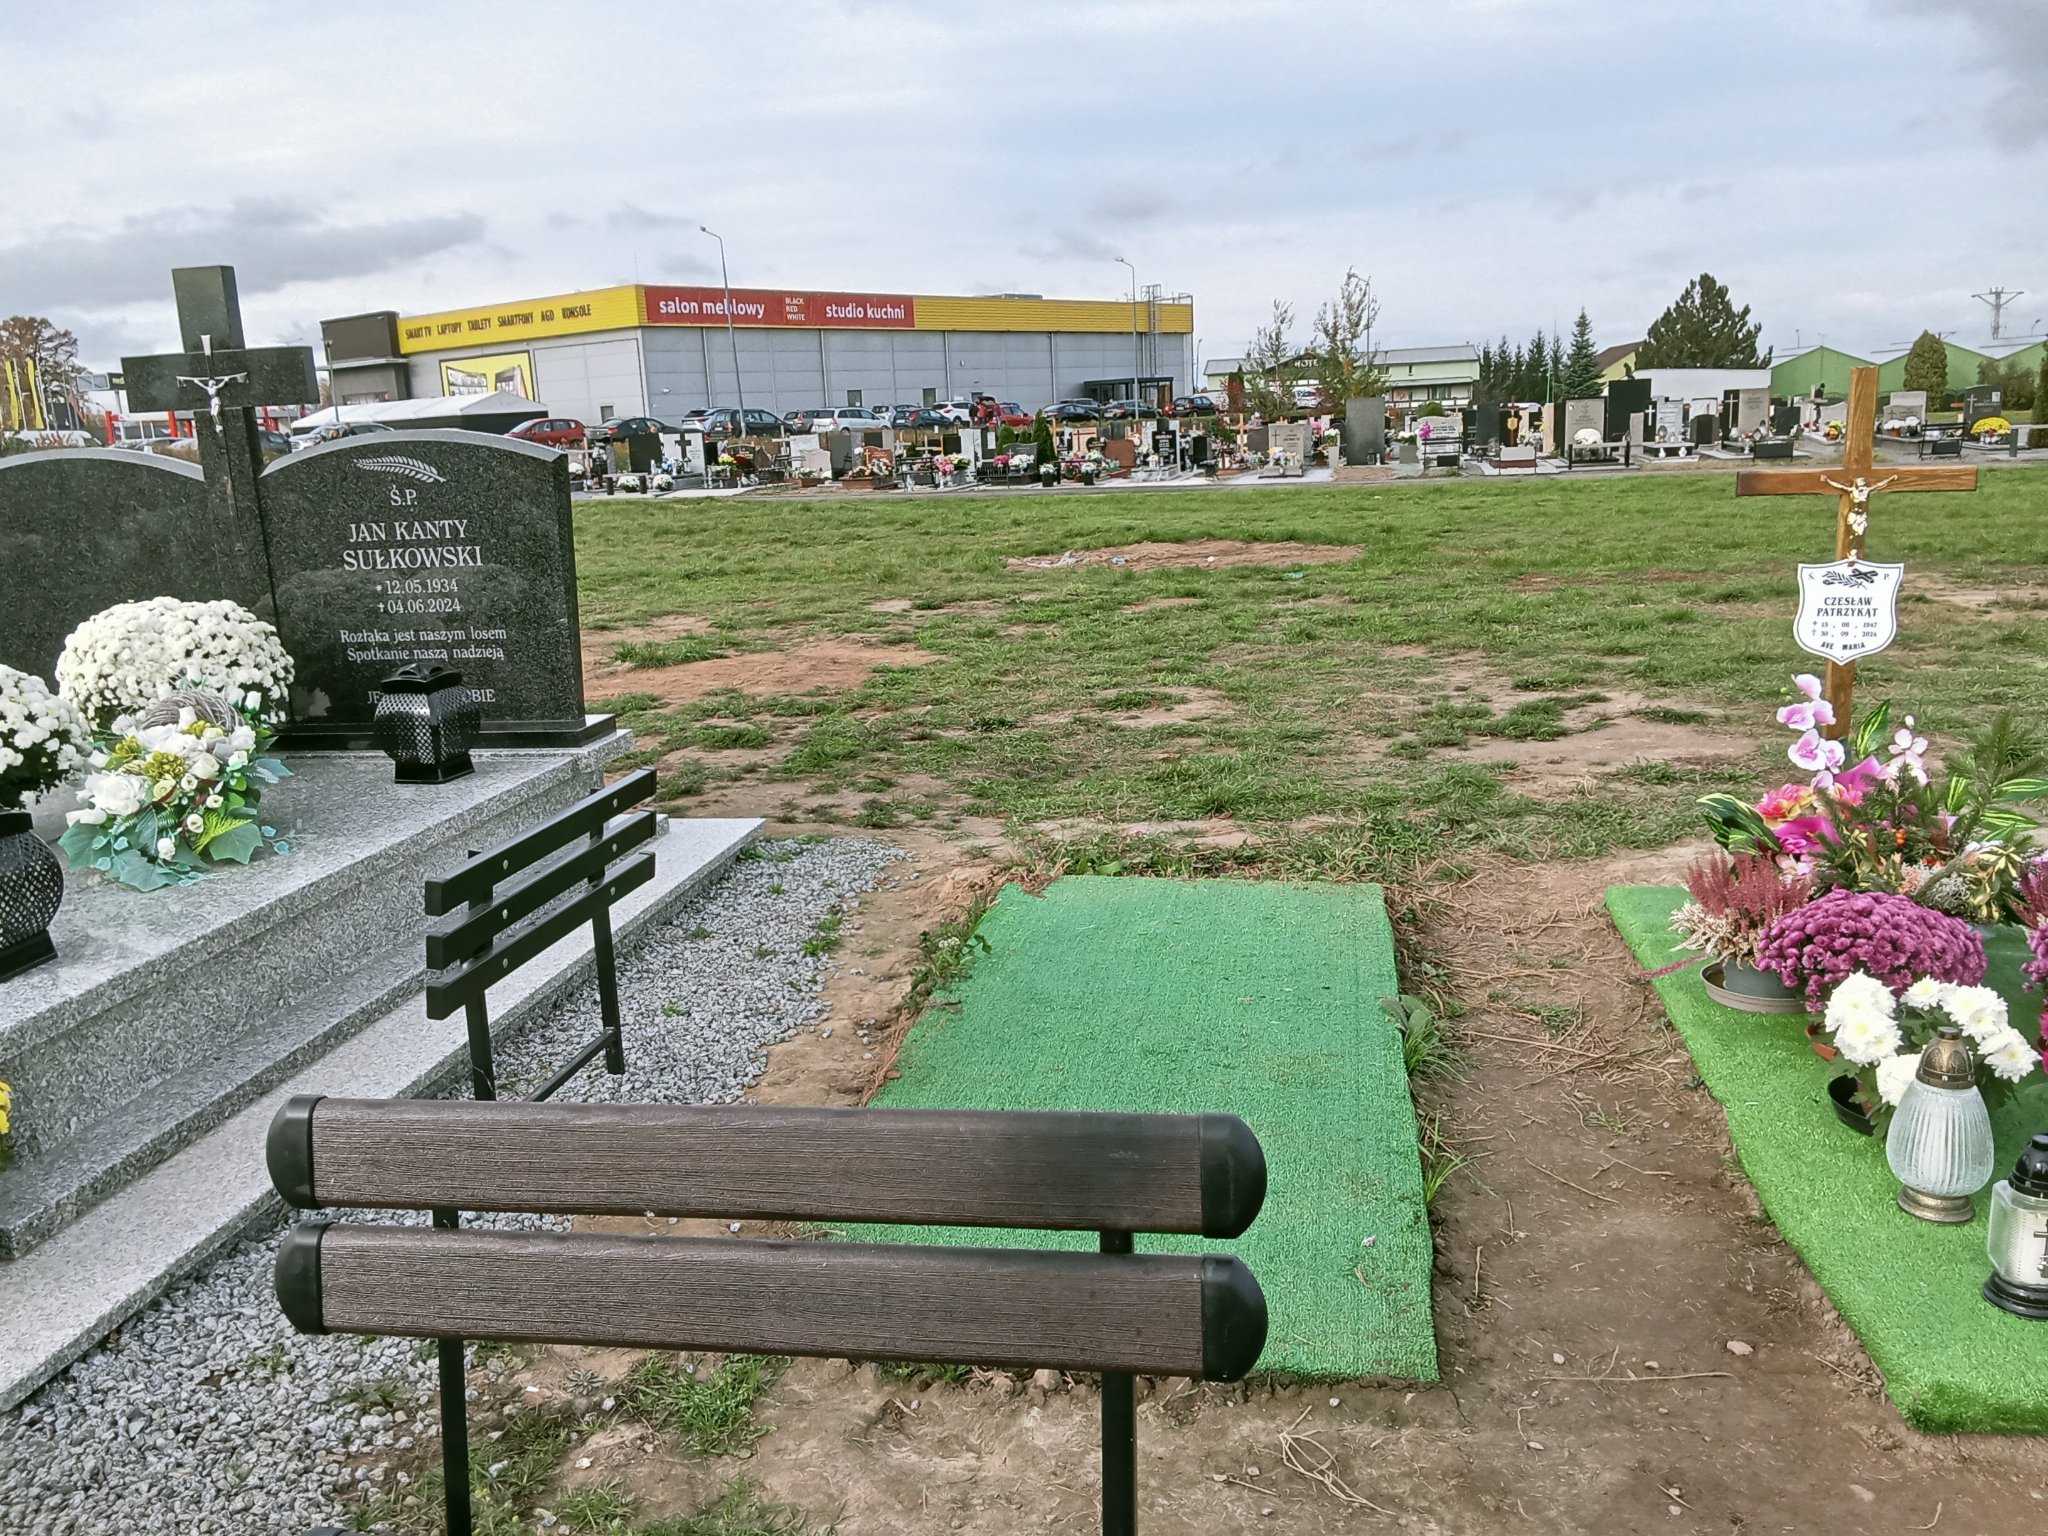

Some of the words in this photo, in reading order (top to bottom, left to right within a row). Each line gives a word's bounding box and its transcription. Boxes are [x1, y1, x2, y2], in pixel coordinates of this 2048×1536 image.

[659, 297, 699, 313] salon
[703, 298, 765, 319] meblowy
[826, 302, 864, 318] studio
[867, 303, 905, 319] kuchni
[405, 327, 423, 339] SMART
[424, 326, 432, 338] TV
[437, 322, 462, 335] LAPTOPY
[467, 318, 492, 331] TABLETY
[498, 312, 534, 327] SMARTFONY
[562, 304, 591, 319] KONSOLE
[787, 313, 806, 321] WHITE
[1294, 358, 1319, 368] HOTE
[349, 522, 386, 543] JAN
[394, 519, 468, 540] KANTY
[342, 545, 484, 571] SUŁKOWSKI
[385, 578, 459, 594] 12.05.1934
[387, 598, 461, 614] 04.06.2024
[1824, 597, 1873, 606] CZESŁAW
[1817, 608, 1878, 618] PATRZYKĄT
[340, 629, 390, 645] Rozłąka
[394, 629, 416, 644] jest
[420, 630, 466, 643] naszym
[471, 626, 508, 640] losem
[1820, 641, 1834, 650] AVE
[1842, 642, 1866, 650] MARIA
[347, 647, 410, 664] Spotkanie
[414, 648, 449, 662] naszą
[453, 644, 505, 661] nadzieją
